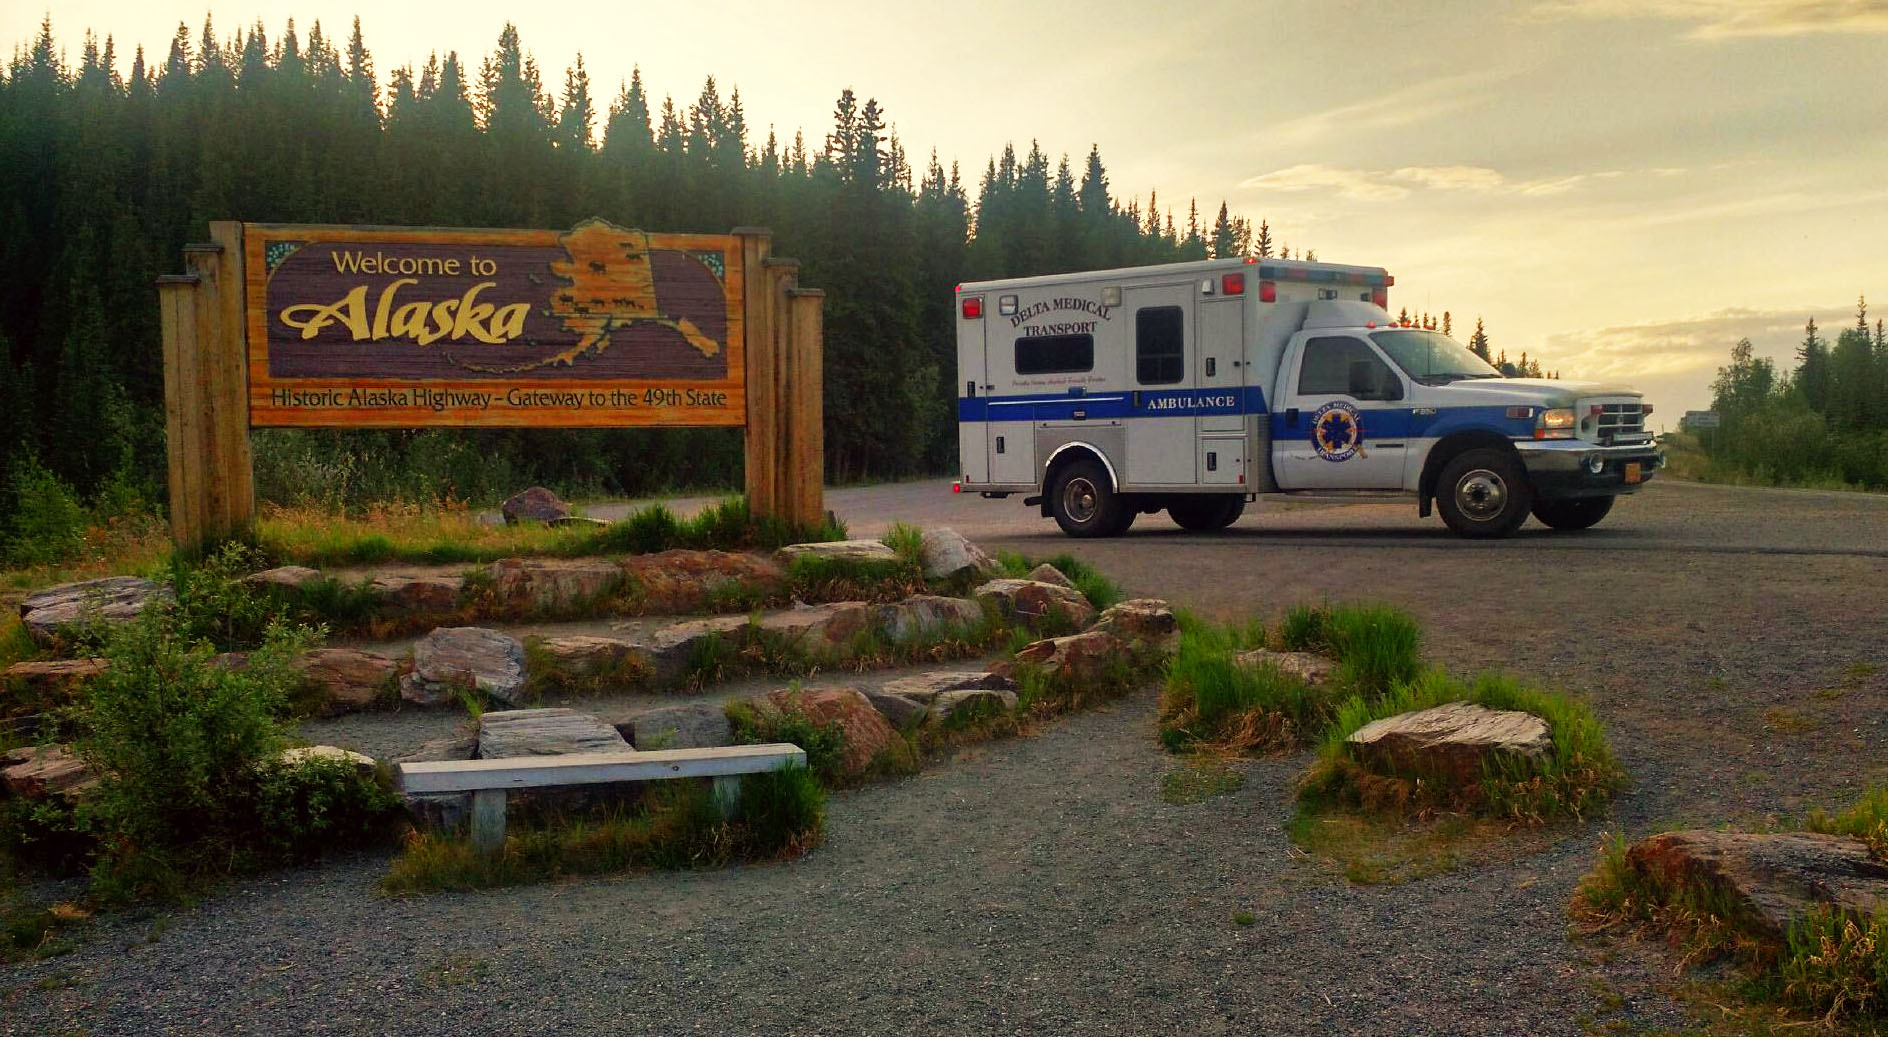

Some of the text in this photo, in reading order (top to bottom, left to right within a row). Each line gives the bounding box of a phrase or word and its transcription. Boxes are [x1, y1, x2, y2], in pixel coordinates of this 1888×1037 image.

[331, 251, 497, 276] Welcome to
[280, 279, 531, 346] Alaska
[1010, 298, 1112, 328] DELTA MEDICAL
[1023, 321, 1097, 337] TRANSPORT
[272, 388, 344, 407] Historic
[349, 388, 408, 407] Alaska
[413, 388, 491, 411] Highway
[506, 388, 584, 410] Gateway
[588, 391, 606, 407] to
[609, 388, 638, 407] the
[642, 388, 682, 407] 49th
[686, 388, 728, 407] State
[1147, 395, 1236, 410] AMBULANCE
